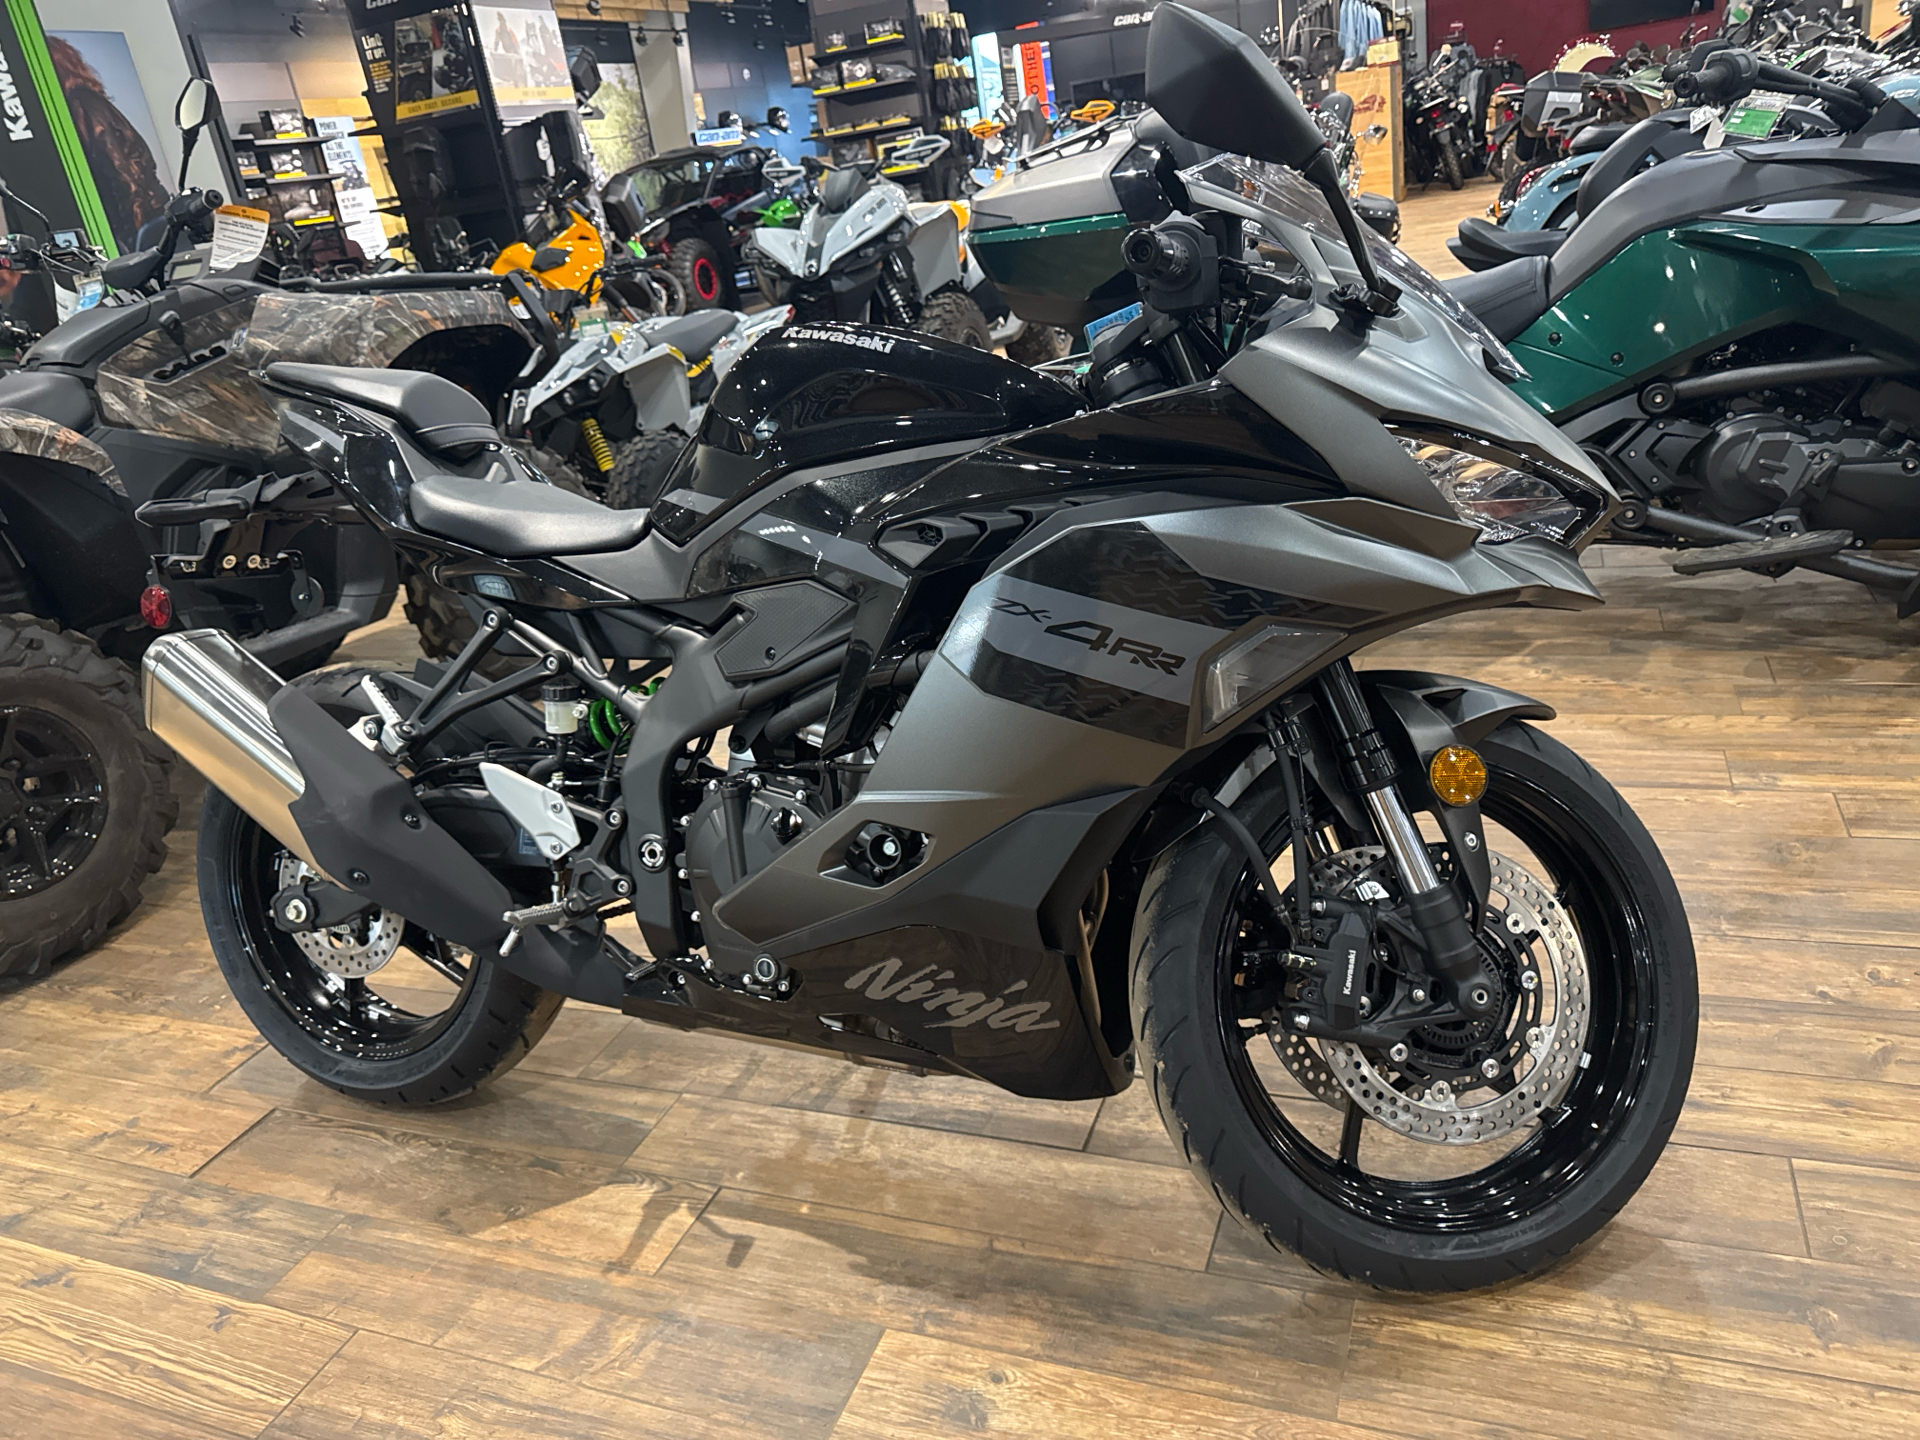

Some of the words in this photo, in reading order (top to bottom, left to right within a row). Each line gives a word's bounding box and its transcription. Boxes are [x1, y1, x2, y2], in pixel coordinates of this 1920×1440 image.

[1113, 11, 1154, 26] can-a
[781, 326, 896, 354] Kawasaki
[1343, 949, 1357, 996] Kawasaki
[844, 957, 1061, 1033] Ninja
